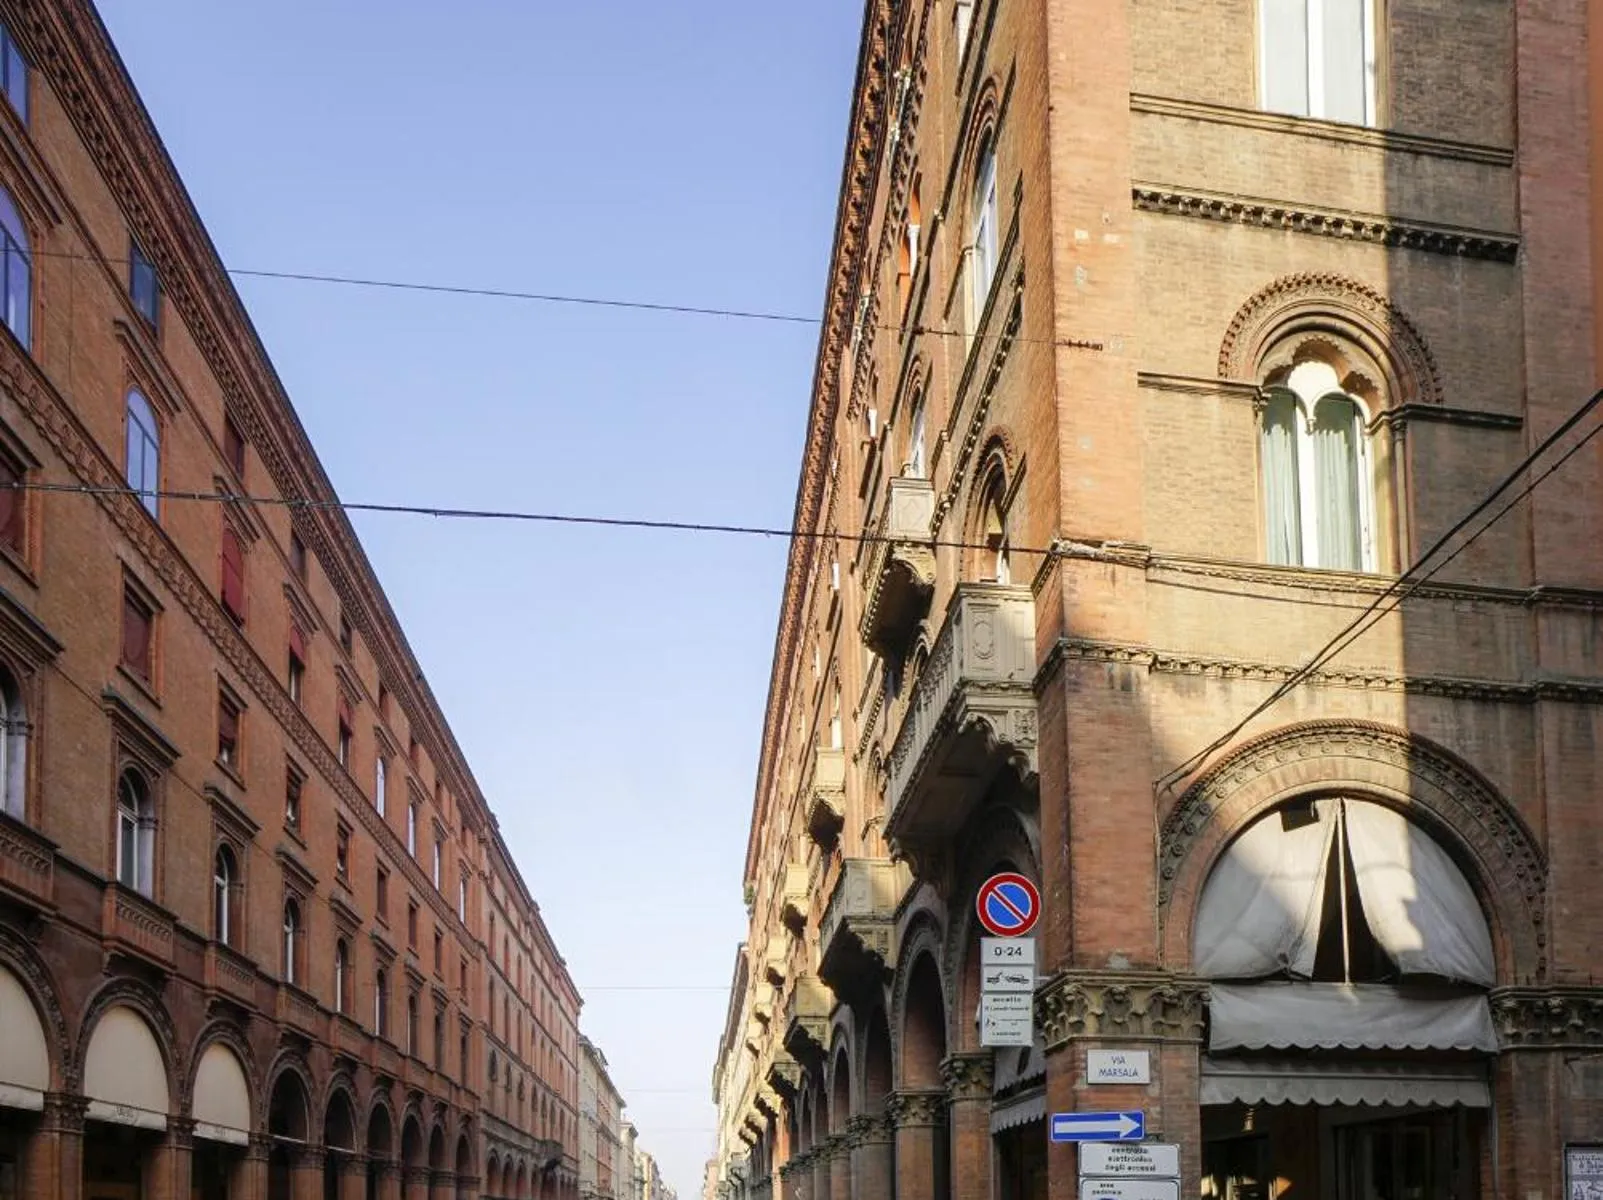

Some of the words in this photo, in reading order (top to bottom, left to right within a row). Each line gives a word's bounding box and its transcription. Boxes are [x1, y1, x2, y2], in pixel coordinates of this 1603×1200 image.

[994, 946, 1022, 956] 0-24
[1111, 1055, 1126, 1064] VIA
[1099, 1068, 1139, 1078] MARSALA
